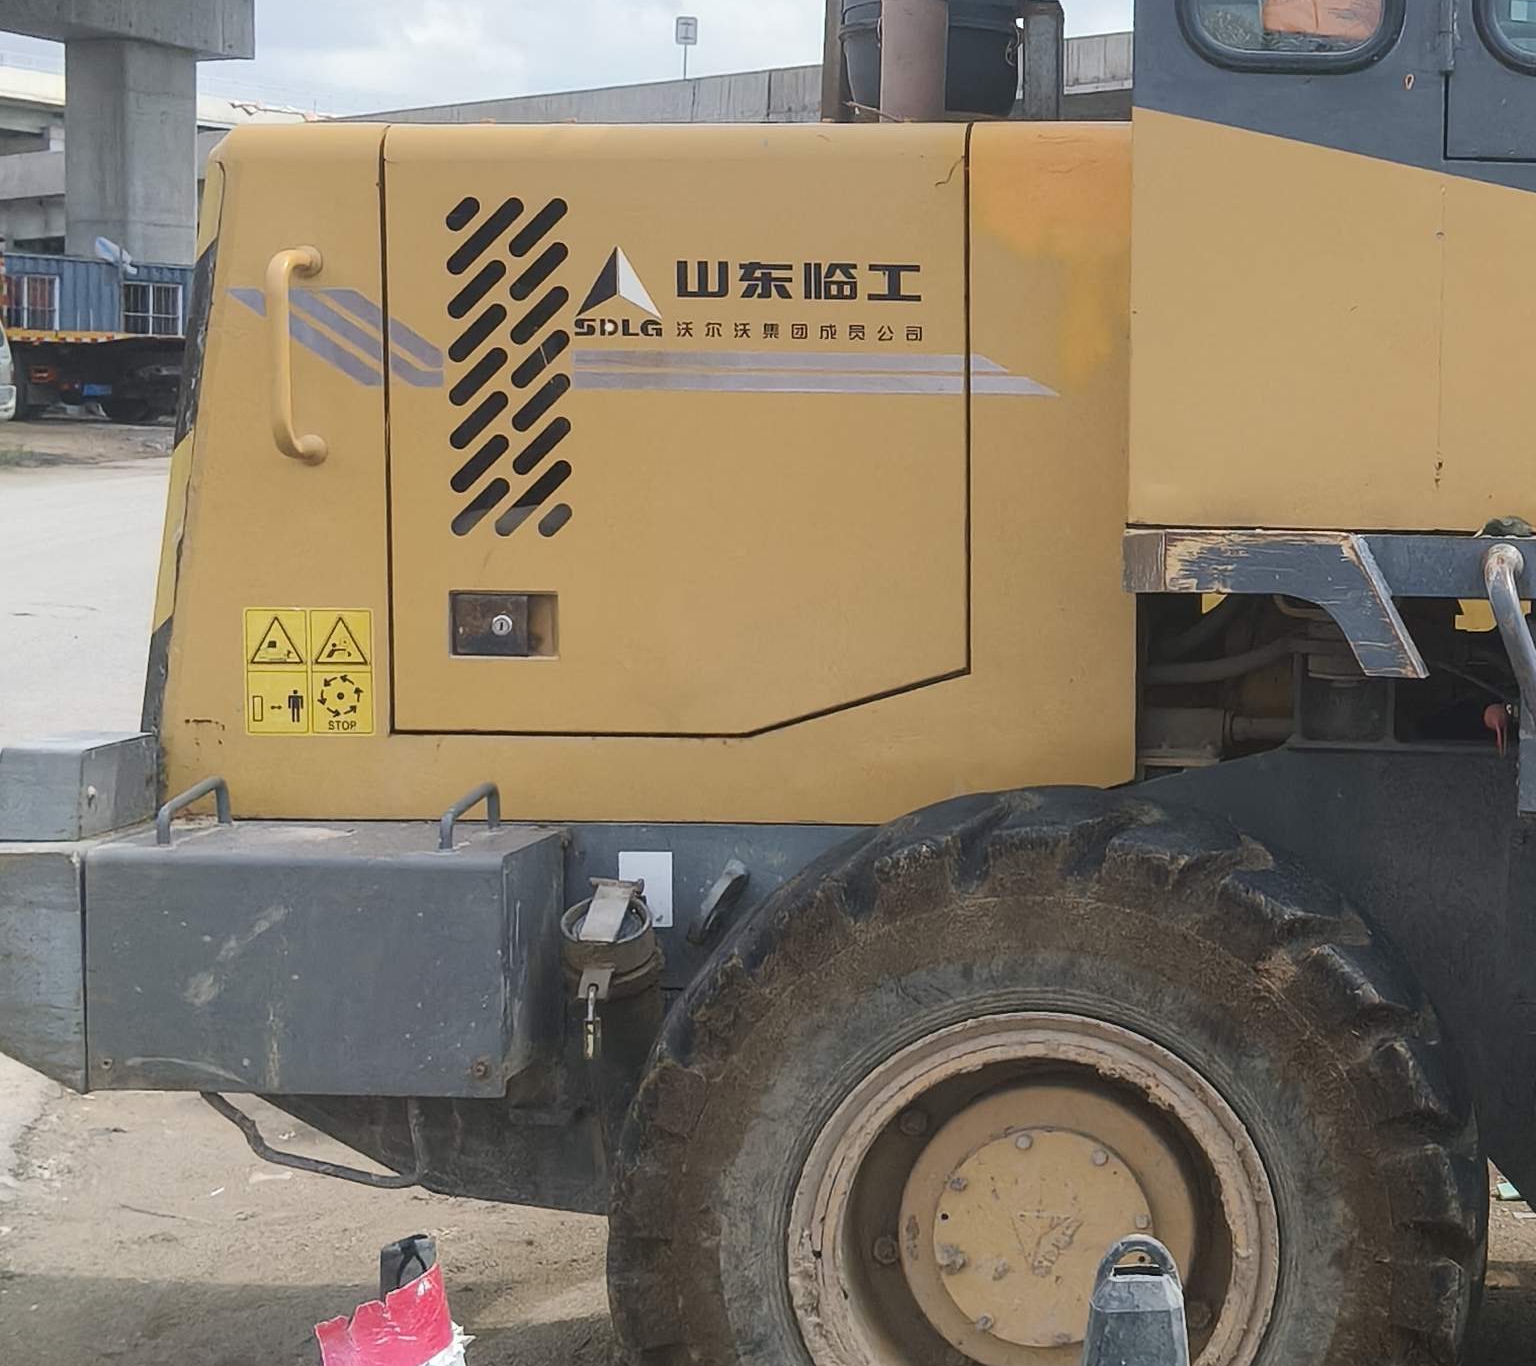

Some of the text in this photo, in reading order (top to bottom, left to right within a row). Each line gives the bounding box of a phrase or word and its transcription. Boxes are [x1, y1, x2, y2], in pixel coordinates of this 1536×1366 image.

[676, 259, 922, 302] 山东临工
[574, 318, 663, 338] SDLG
[676, 321, 923, 342] 沃尔沃集团成员公司
[328, 720, 357, 732] STOP
